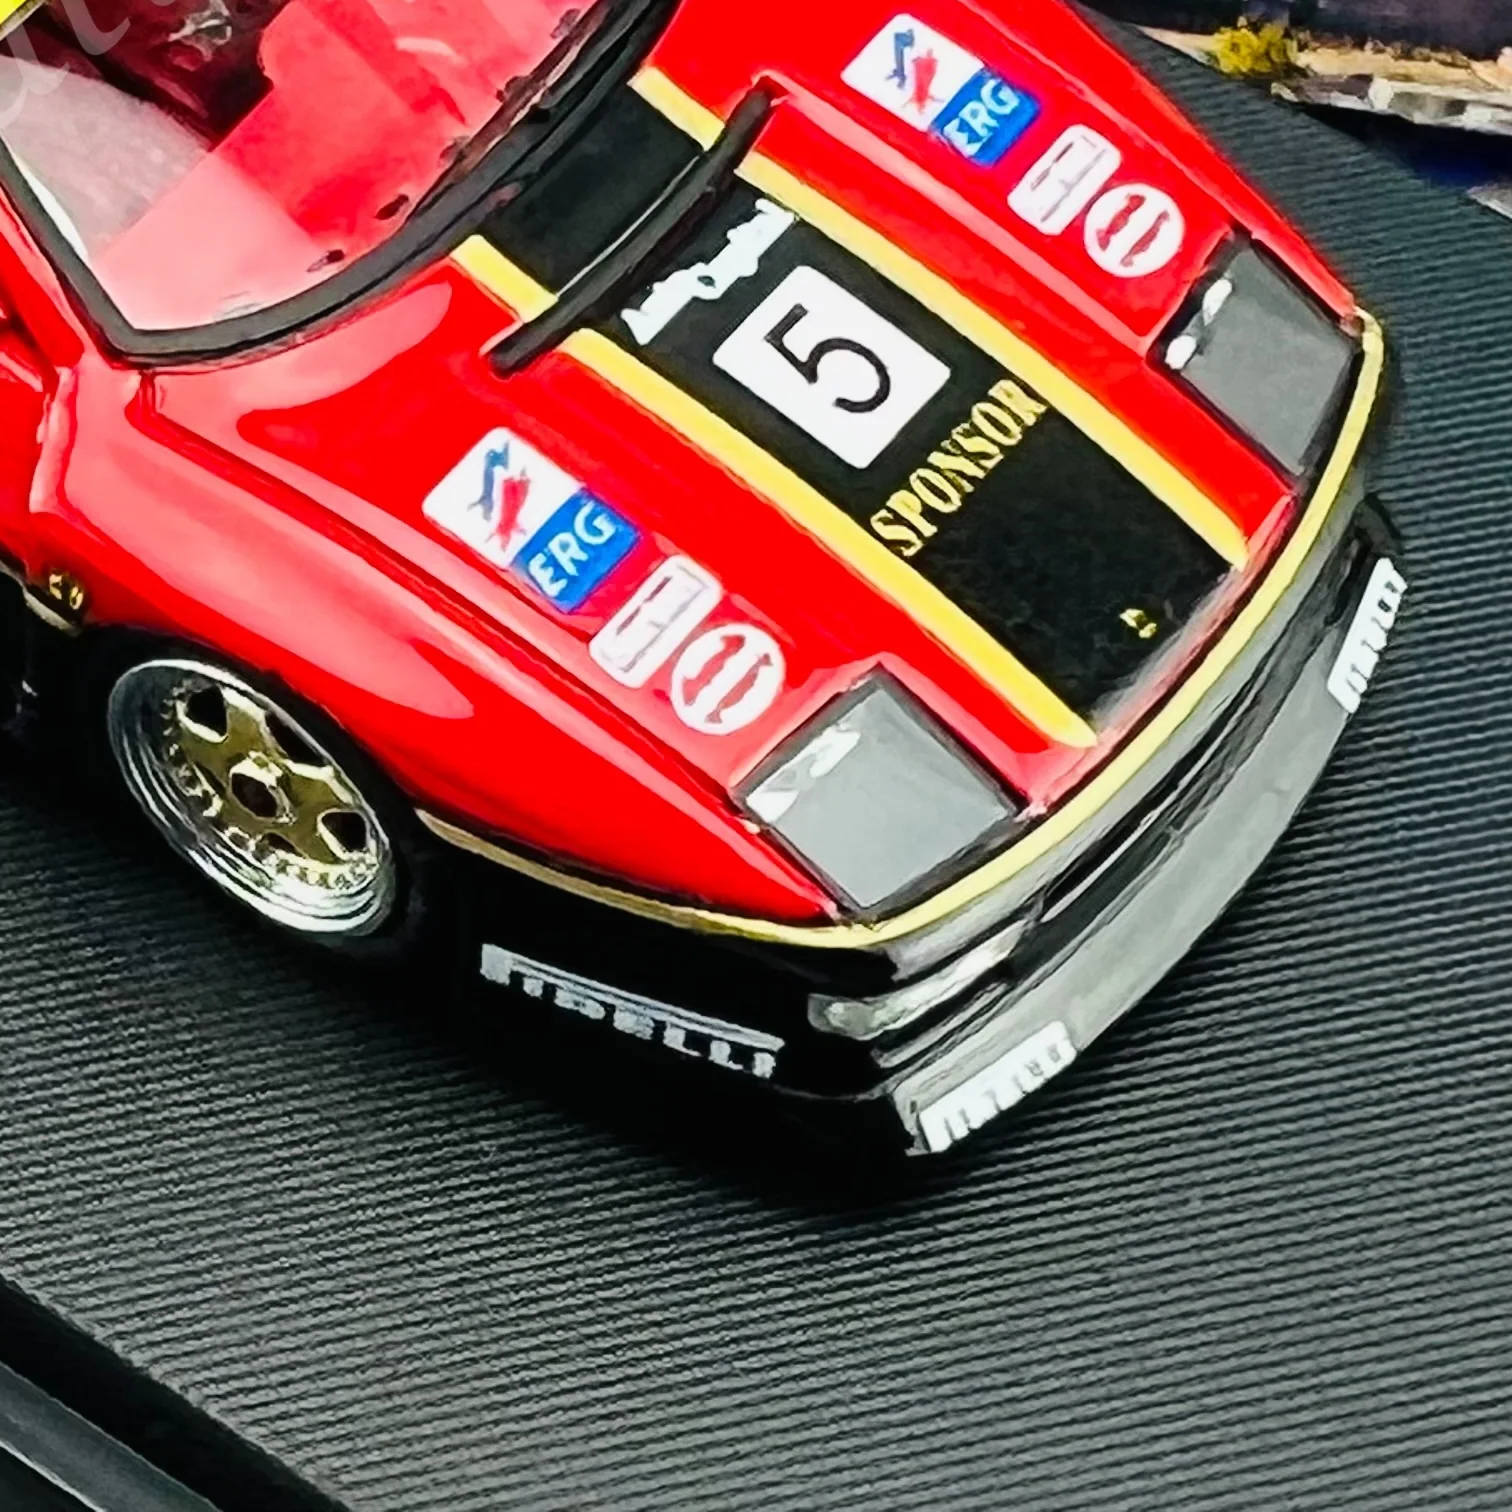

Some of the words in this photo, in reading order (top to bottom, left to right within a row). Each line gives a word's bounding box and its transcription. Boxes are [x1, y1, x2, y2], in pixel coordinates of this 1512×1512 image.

[943, 78, 1020, 157] ERG
[765, 303, 891, 414] 5
[870, 379, 1051, 557] SPONSOR
[527, 499, 617, 598] ERG
